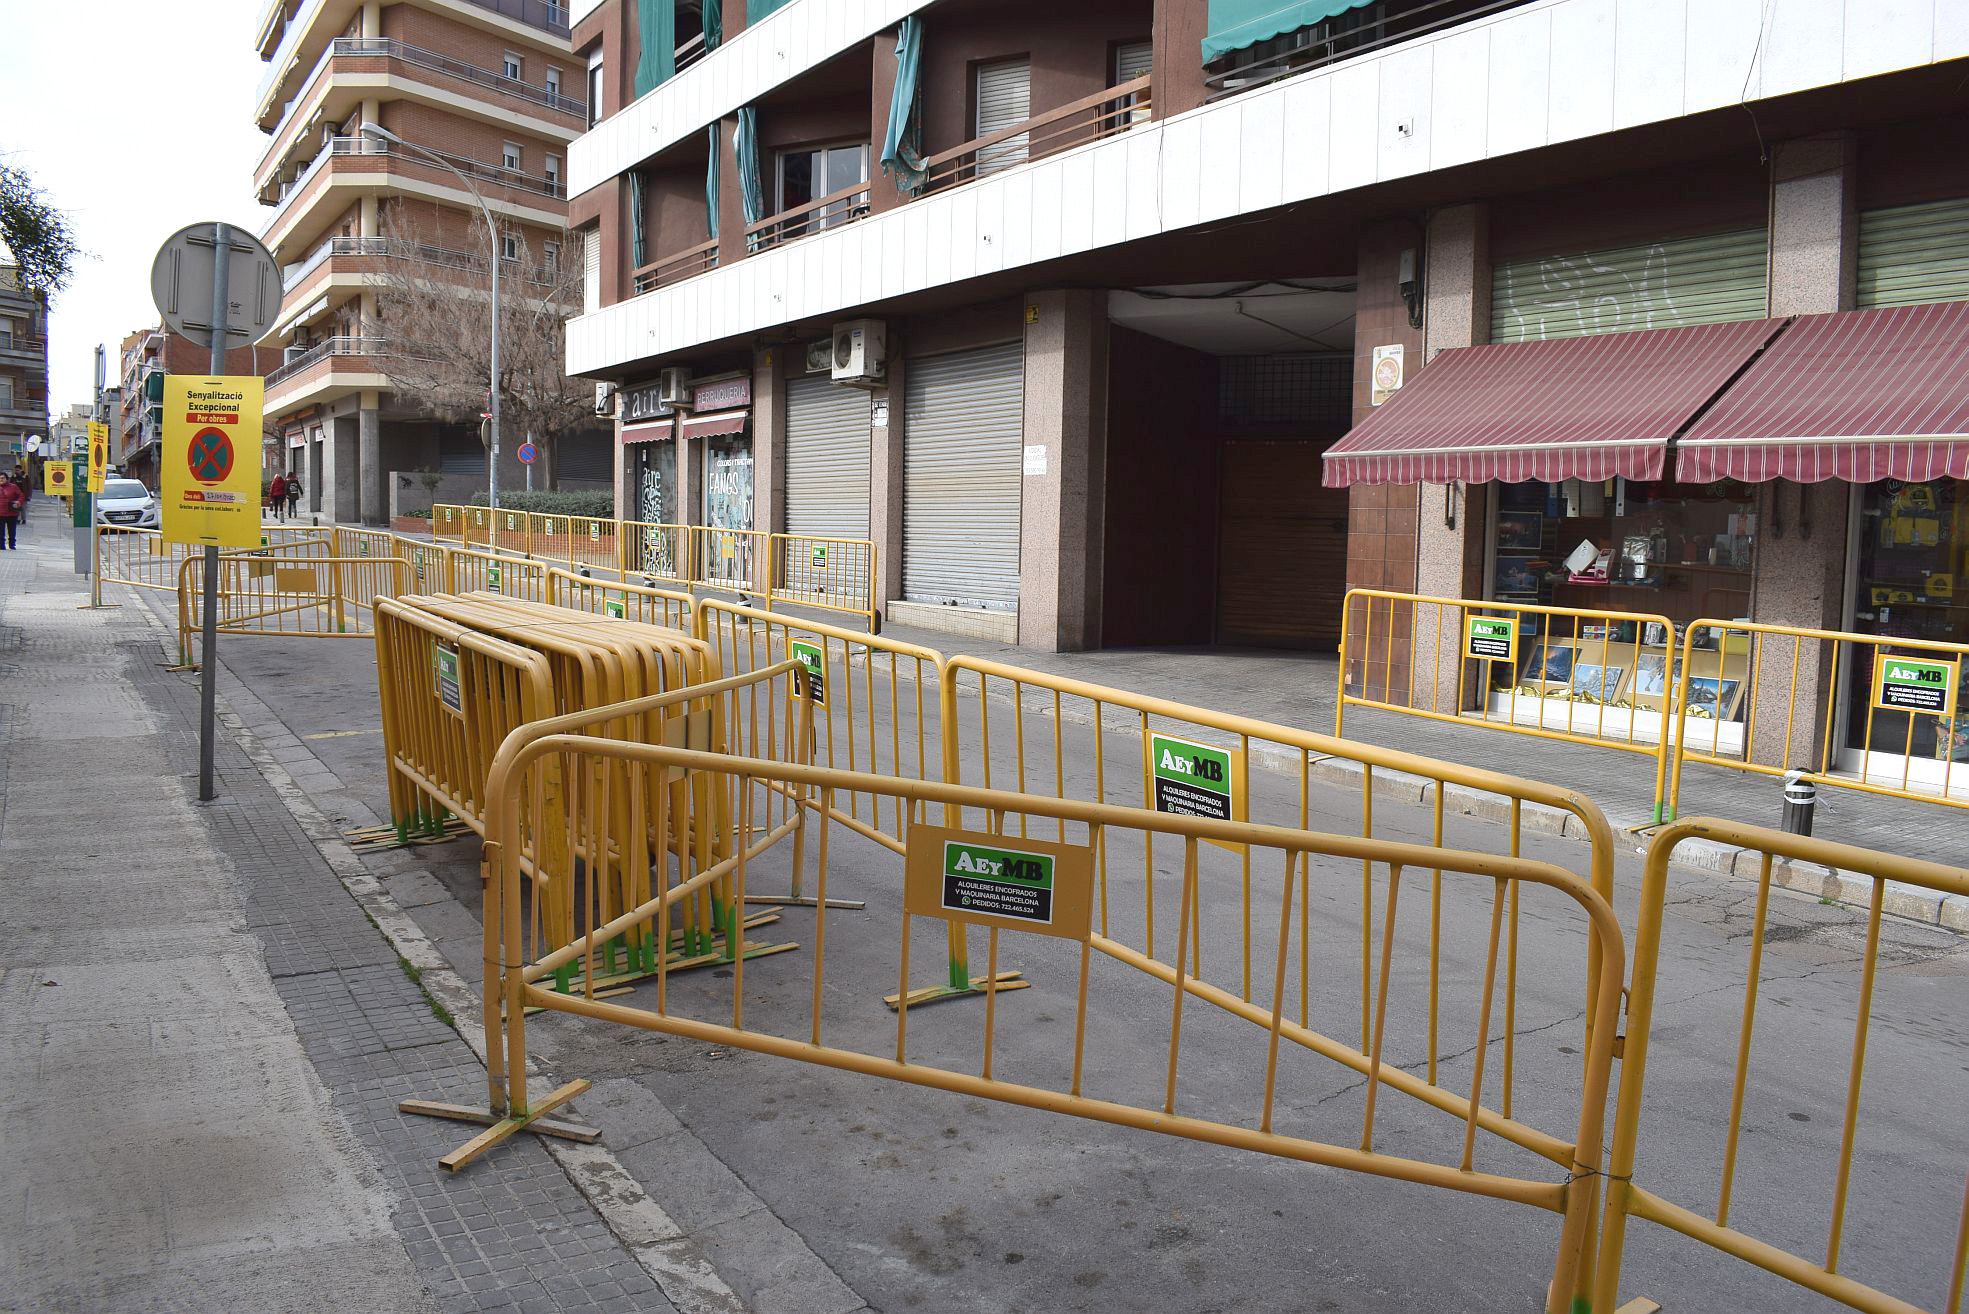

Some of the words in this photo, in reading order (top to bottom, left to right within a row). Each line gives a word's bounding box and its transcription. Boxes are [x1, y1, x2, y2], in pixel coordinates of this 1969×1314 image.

[187, 390, 243, 401] Senyalització
[697, 385, 746, 405] PERRUQUERIA
[188, 402, 240, 413] Excepcional
[197, 414, 208, 422] Per
[209, 415, 227, 423] obres
[642, 467, 661, 489] aire
[709, 472, 739, 495] FANGS
[1163, 785, 1190, 798] ALQUILERES
[1190, 792, 1222, 807] ENCOFRADOS
[1166, 794, 1195, 809] MAQUINARIA
[1196, 802, 1224, 818] BARCELONA
[957, 881, 994, 892] ALQUILERES
[995, 886, 1038, 898] ENCOFRADOS
[960, 889, 1000, 901] MAQUINARIA
[1001, 895, 1039, 906] BARCELONA
[972, 899, 1001, 909] PEDIDOS:
